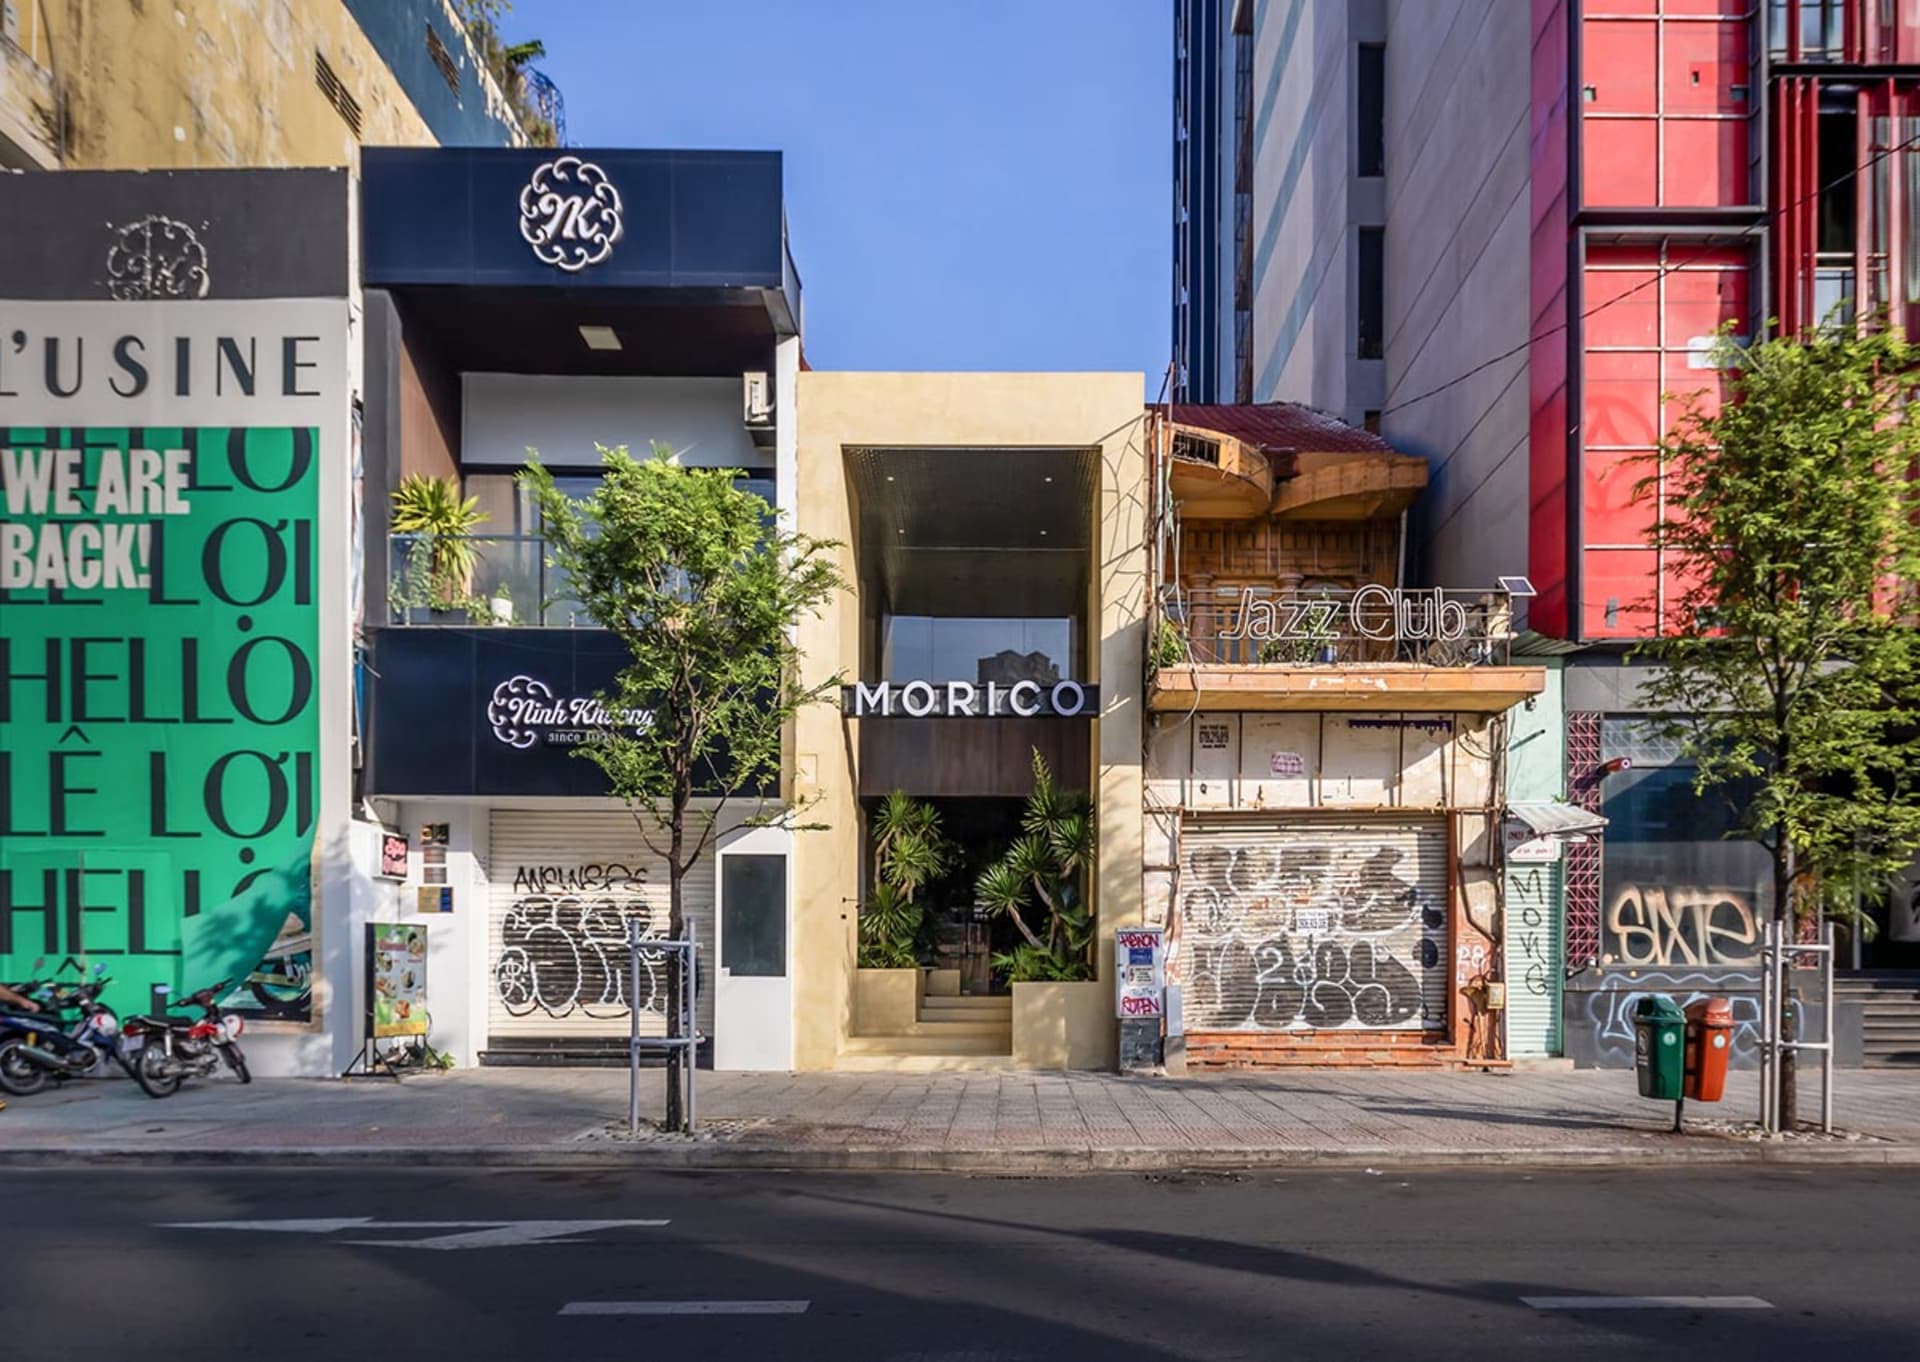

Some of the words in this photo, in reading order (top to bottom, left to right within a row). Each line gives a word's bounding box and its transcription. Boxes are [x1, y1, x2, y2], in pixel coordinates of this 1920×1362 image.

[3, 449, 82, 514] WE
[94, 449, 191, 514] ARE
[0, 523, 152, 589] BACK!
[1219, 586, 1341, 640] Jazz
[1350, 583, 1466, 641] Club
[508, 697, 568, 727] Ninh
[855, 680, 1085, 717] MORICO
